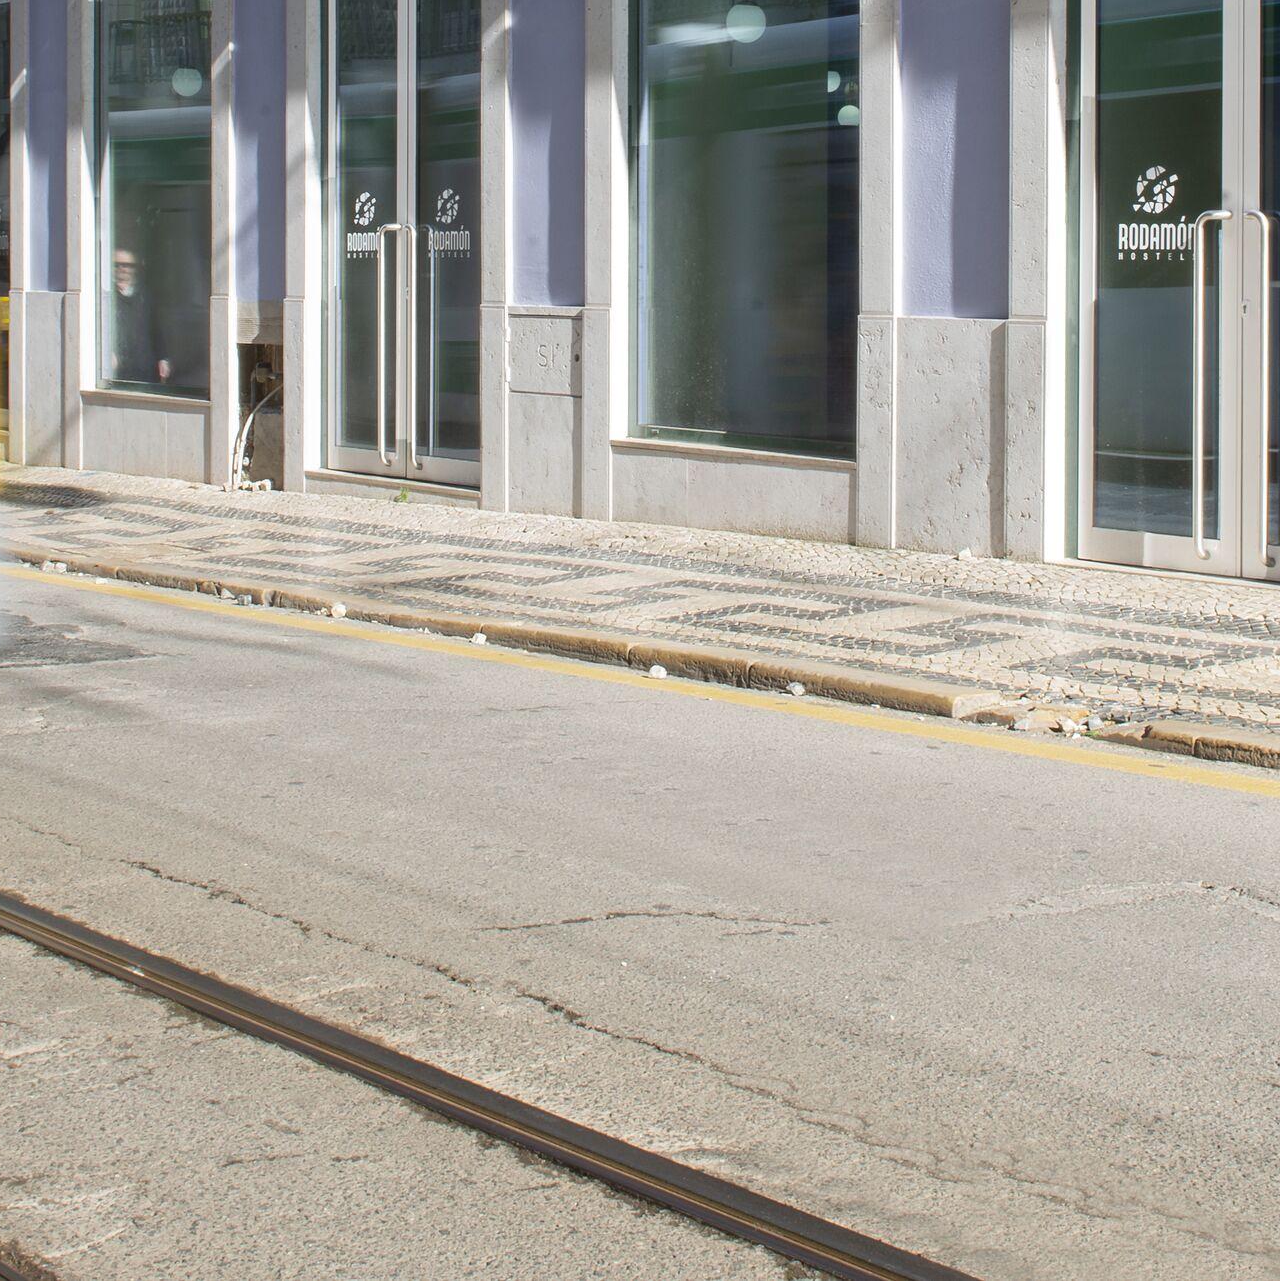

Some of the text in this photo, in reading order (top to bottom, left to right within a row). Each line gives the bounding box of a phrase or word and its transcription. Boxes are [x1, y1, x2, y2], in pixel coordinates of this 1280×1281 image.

[347, 226, 380, 252] RODAMÓ
[428, 224, 470, 250] RODAMÓN
[1118, 252, 1195, 260] HOSTEL
